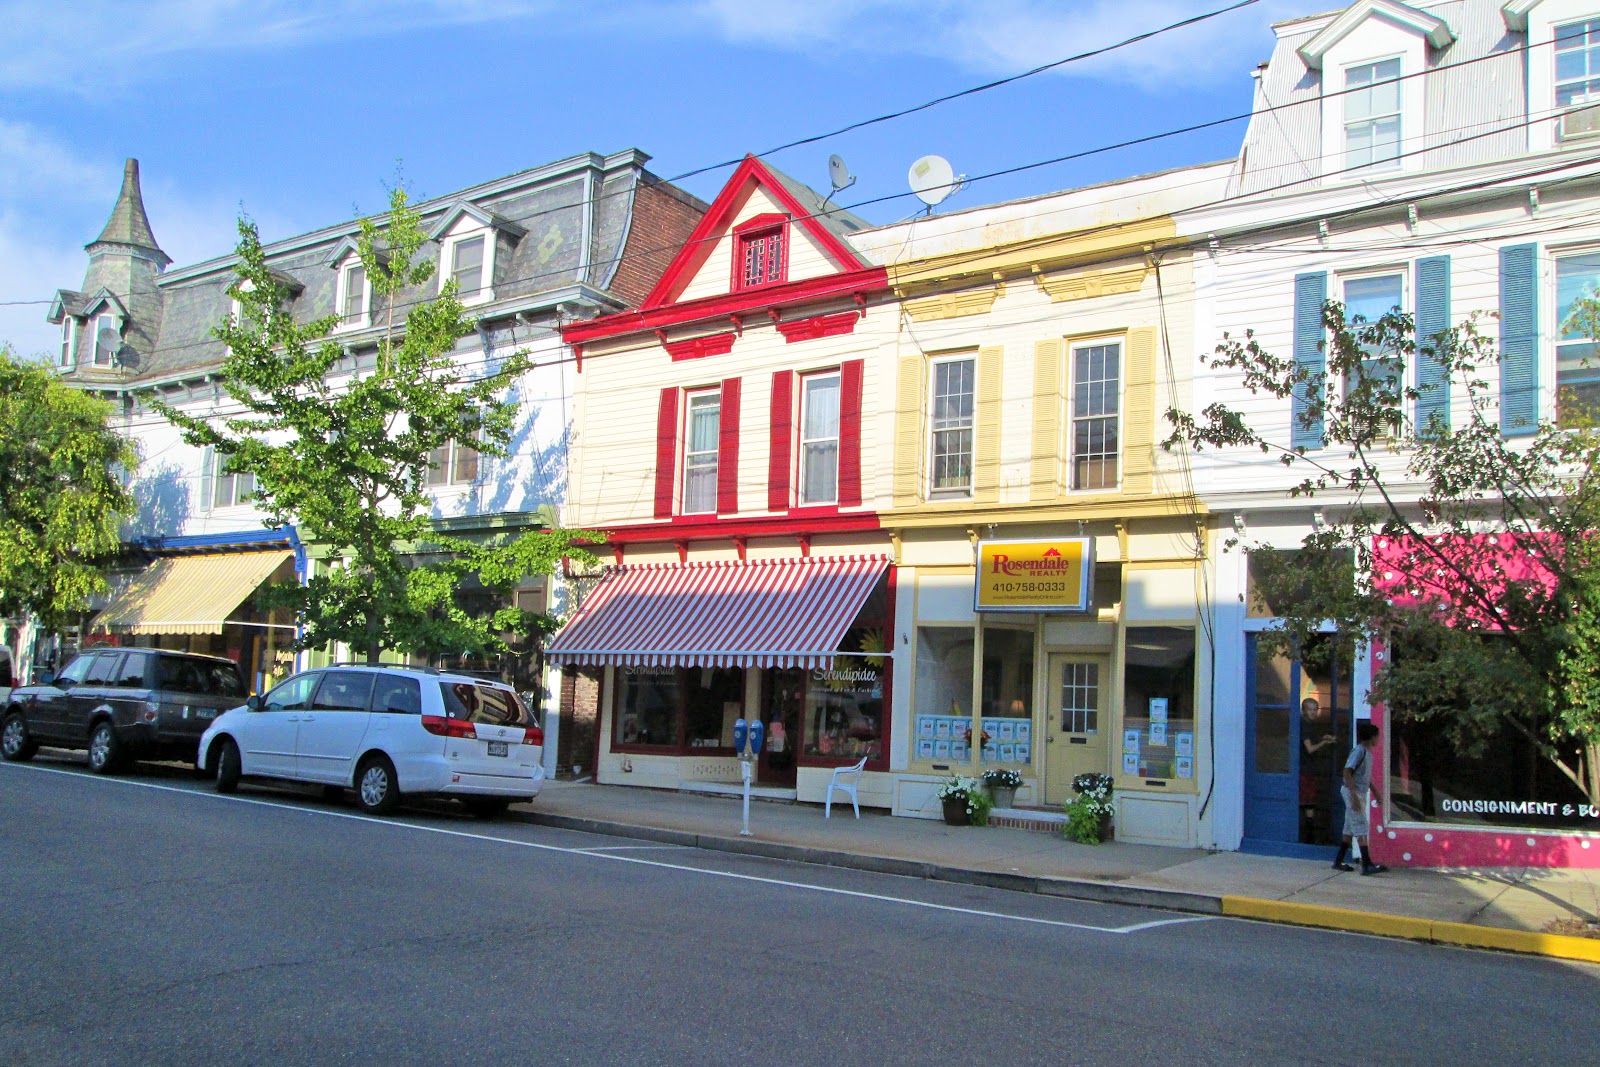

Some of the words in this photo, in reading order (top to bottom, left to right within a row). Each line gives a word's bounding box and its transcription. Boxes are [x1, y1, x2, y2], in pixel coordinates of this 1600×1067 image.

[991, 554, 1069, 576] Rosendale
[992, 582, 1065, 592] 410-758-0333
[813, 667, 877, 683] Serendipidee
[1442, 799, 1558, 816] CONSIGNMENT
[1562, 803, 1575, 817] &
